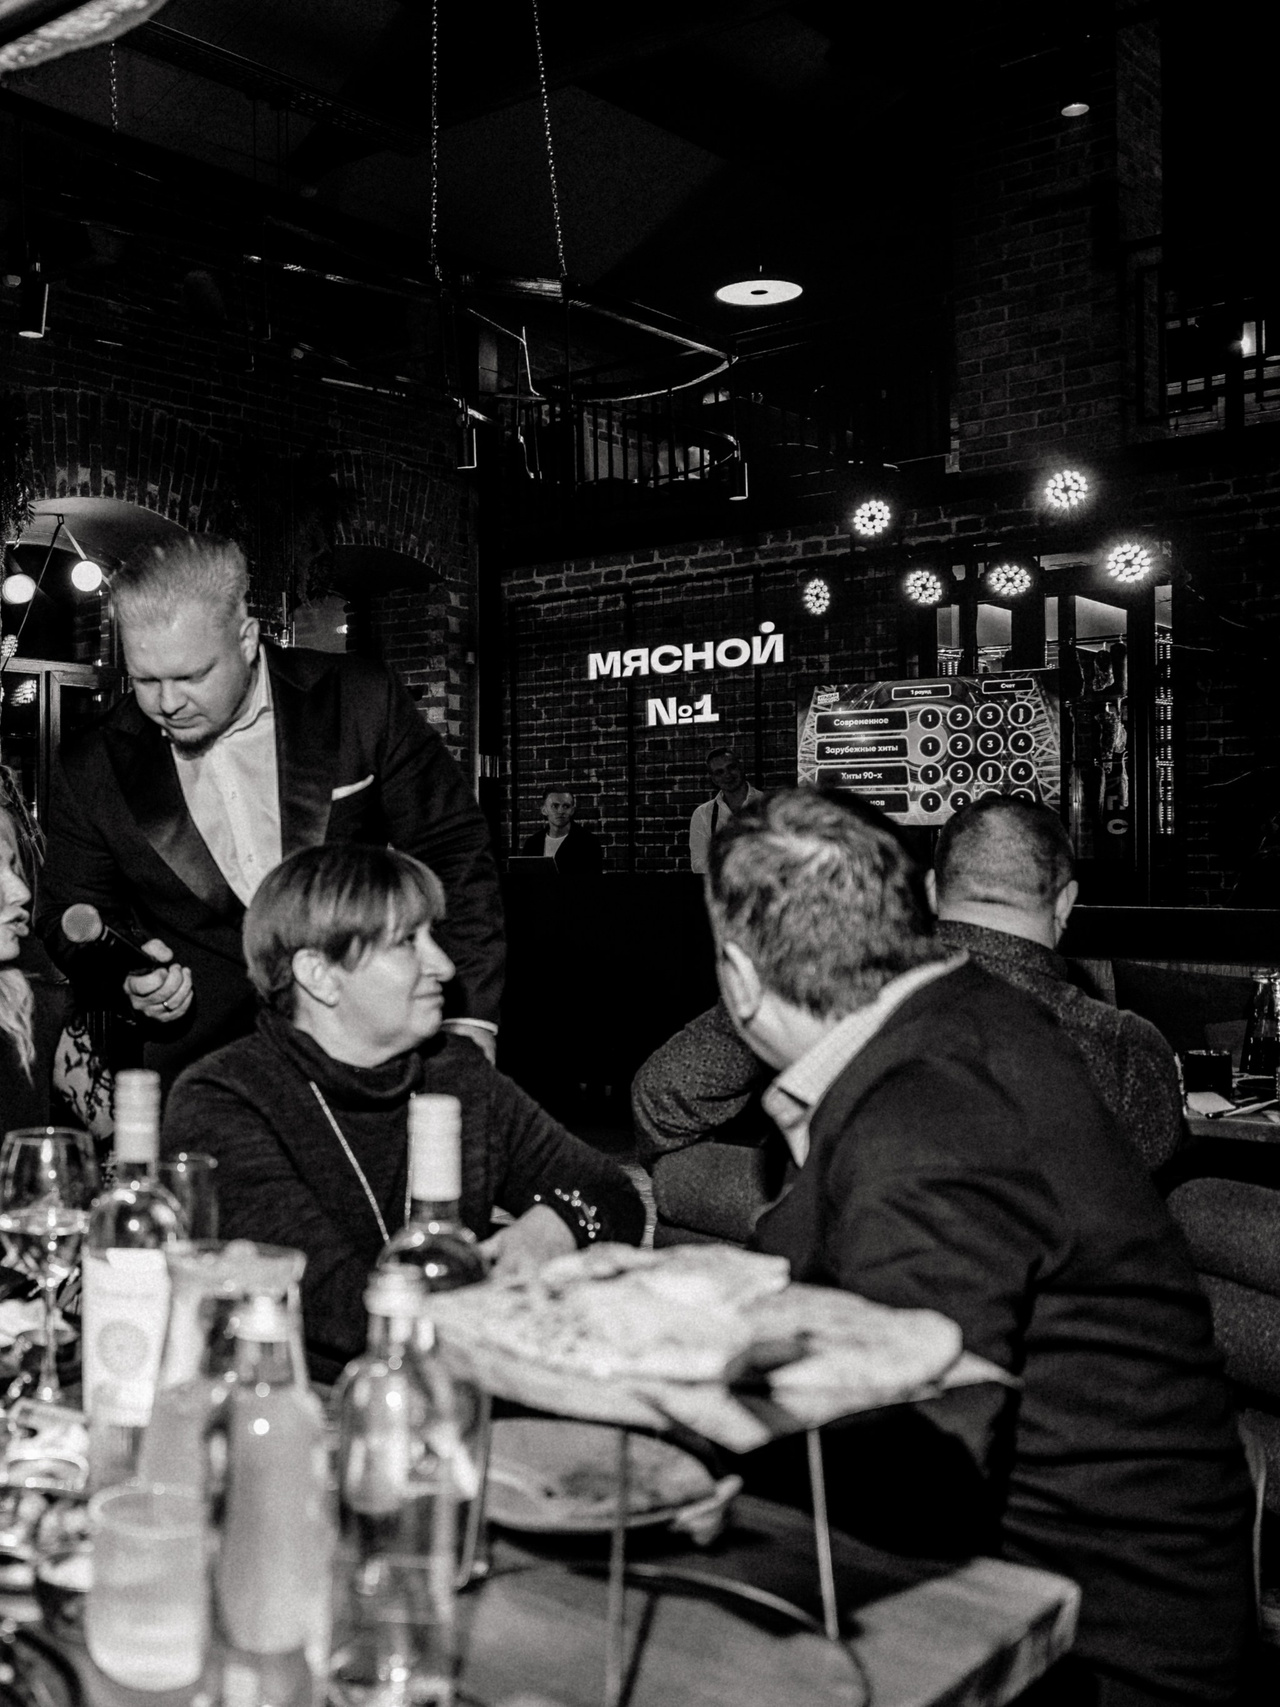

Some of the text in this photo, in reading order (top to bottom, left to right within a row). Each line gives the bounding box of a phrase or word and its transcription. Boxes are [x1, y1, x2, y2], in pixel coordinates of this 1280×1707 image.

[588, 621, 785, 680] МЯСНОЙ
[647, 693, 720, 727] №1
[833, 717, 889, 727] Современное
[927, 711, 993, 722] 1 2 3
[825, 744, 899, 755] Зарубежные хиты
[927, 742, 932, 750] 1
[956, 741, 963, 749] 2
[987, 740, 994, 748] 3
[841, 771, 883, 780] Хиты 90-х
[928, 767, 1025, 778] 1 2 4
[928, 797, 964, 806] 1 2
